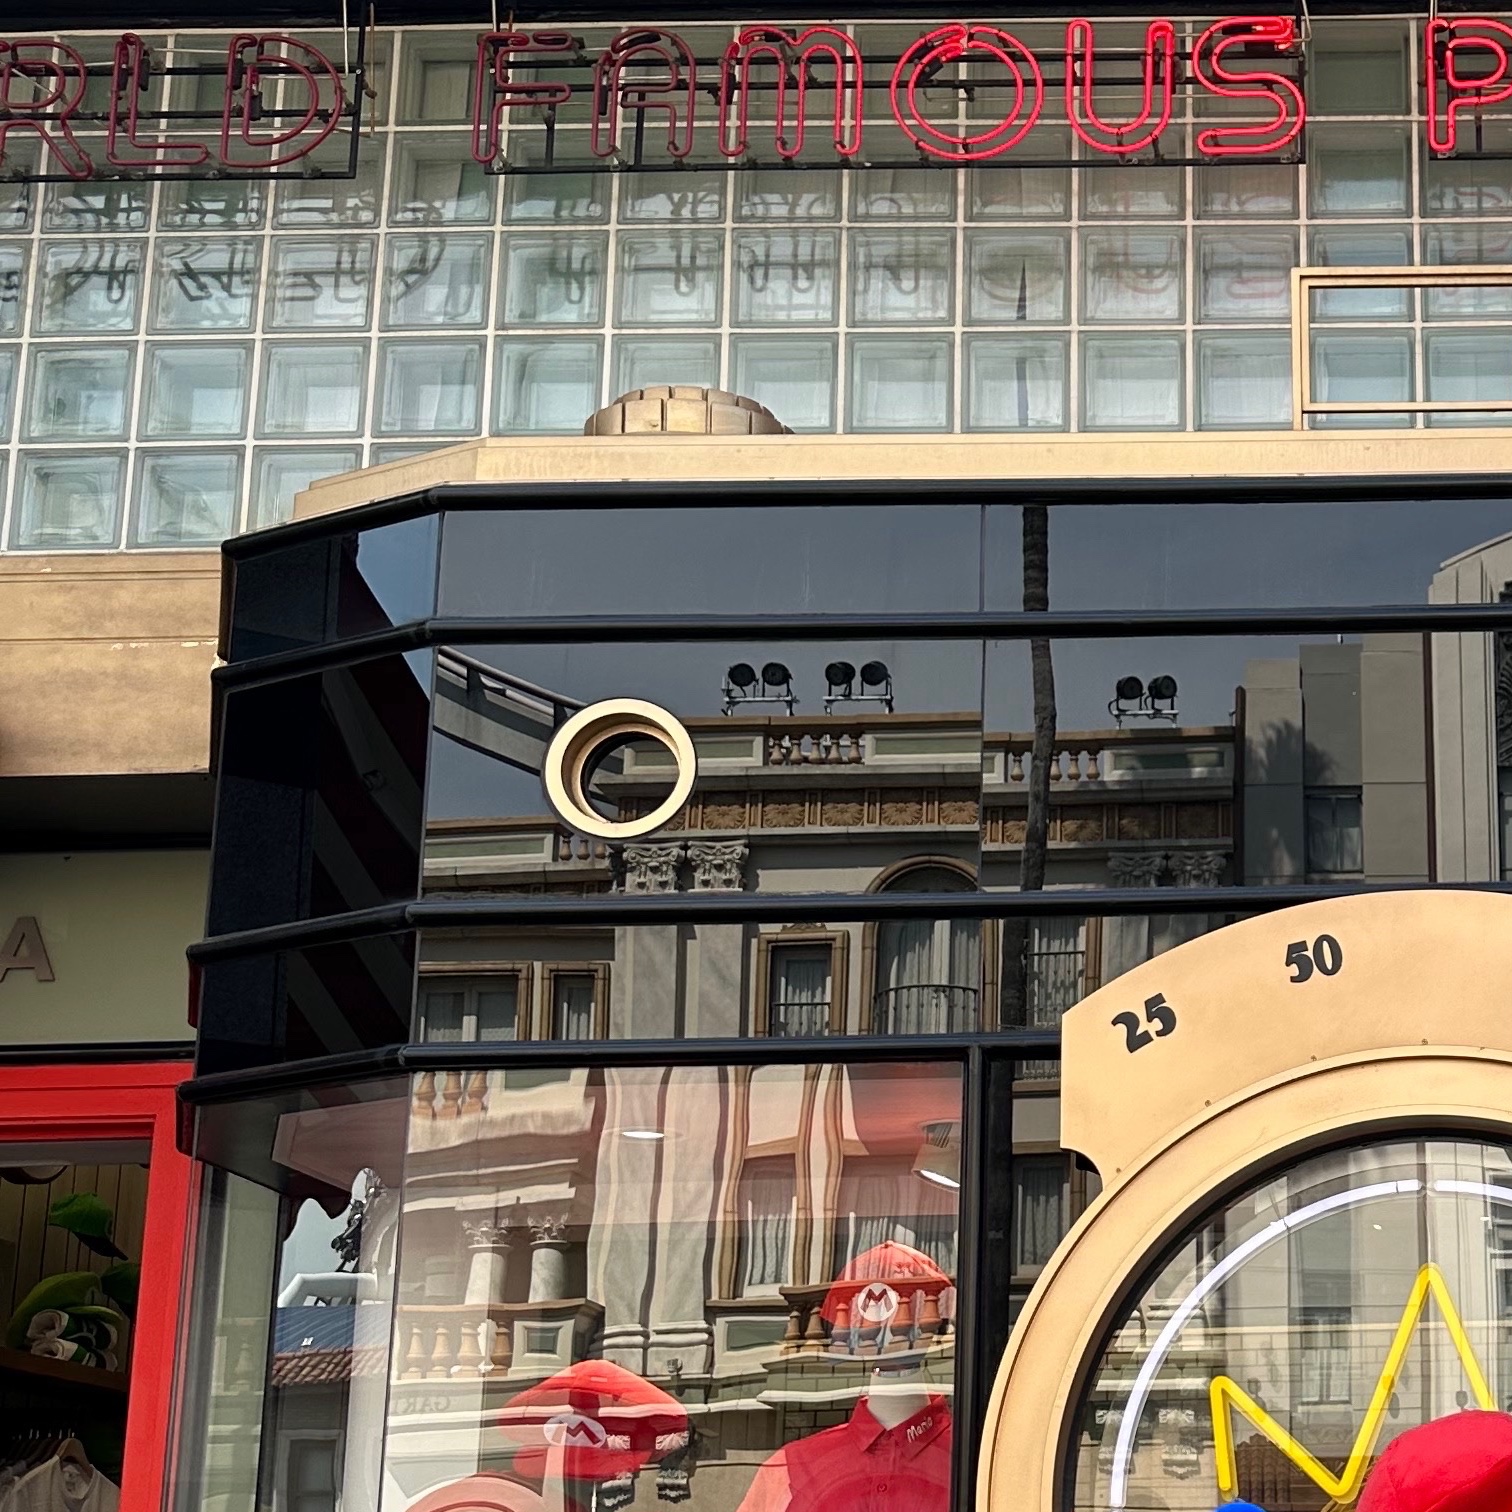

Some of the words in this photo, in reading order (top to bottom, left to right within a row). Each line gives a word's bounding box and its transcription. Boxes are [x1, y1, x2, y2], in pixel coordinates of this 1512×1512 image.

[472, 16, 1306, 163] FAMOUS
[1111, 992, 1178, 1054] 25
[1284, 933, 1343, 984] 50
[860, 1287, 894, 1313] M
[551, 1420, 601, 1446] M
[906, 1416, 933, 1444] Mario
